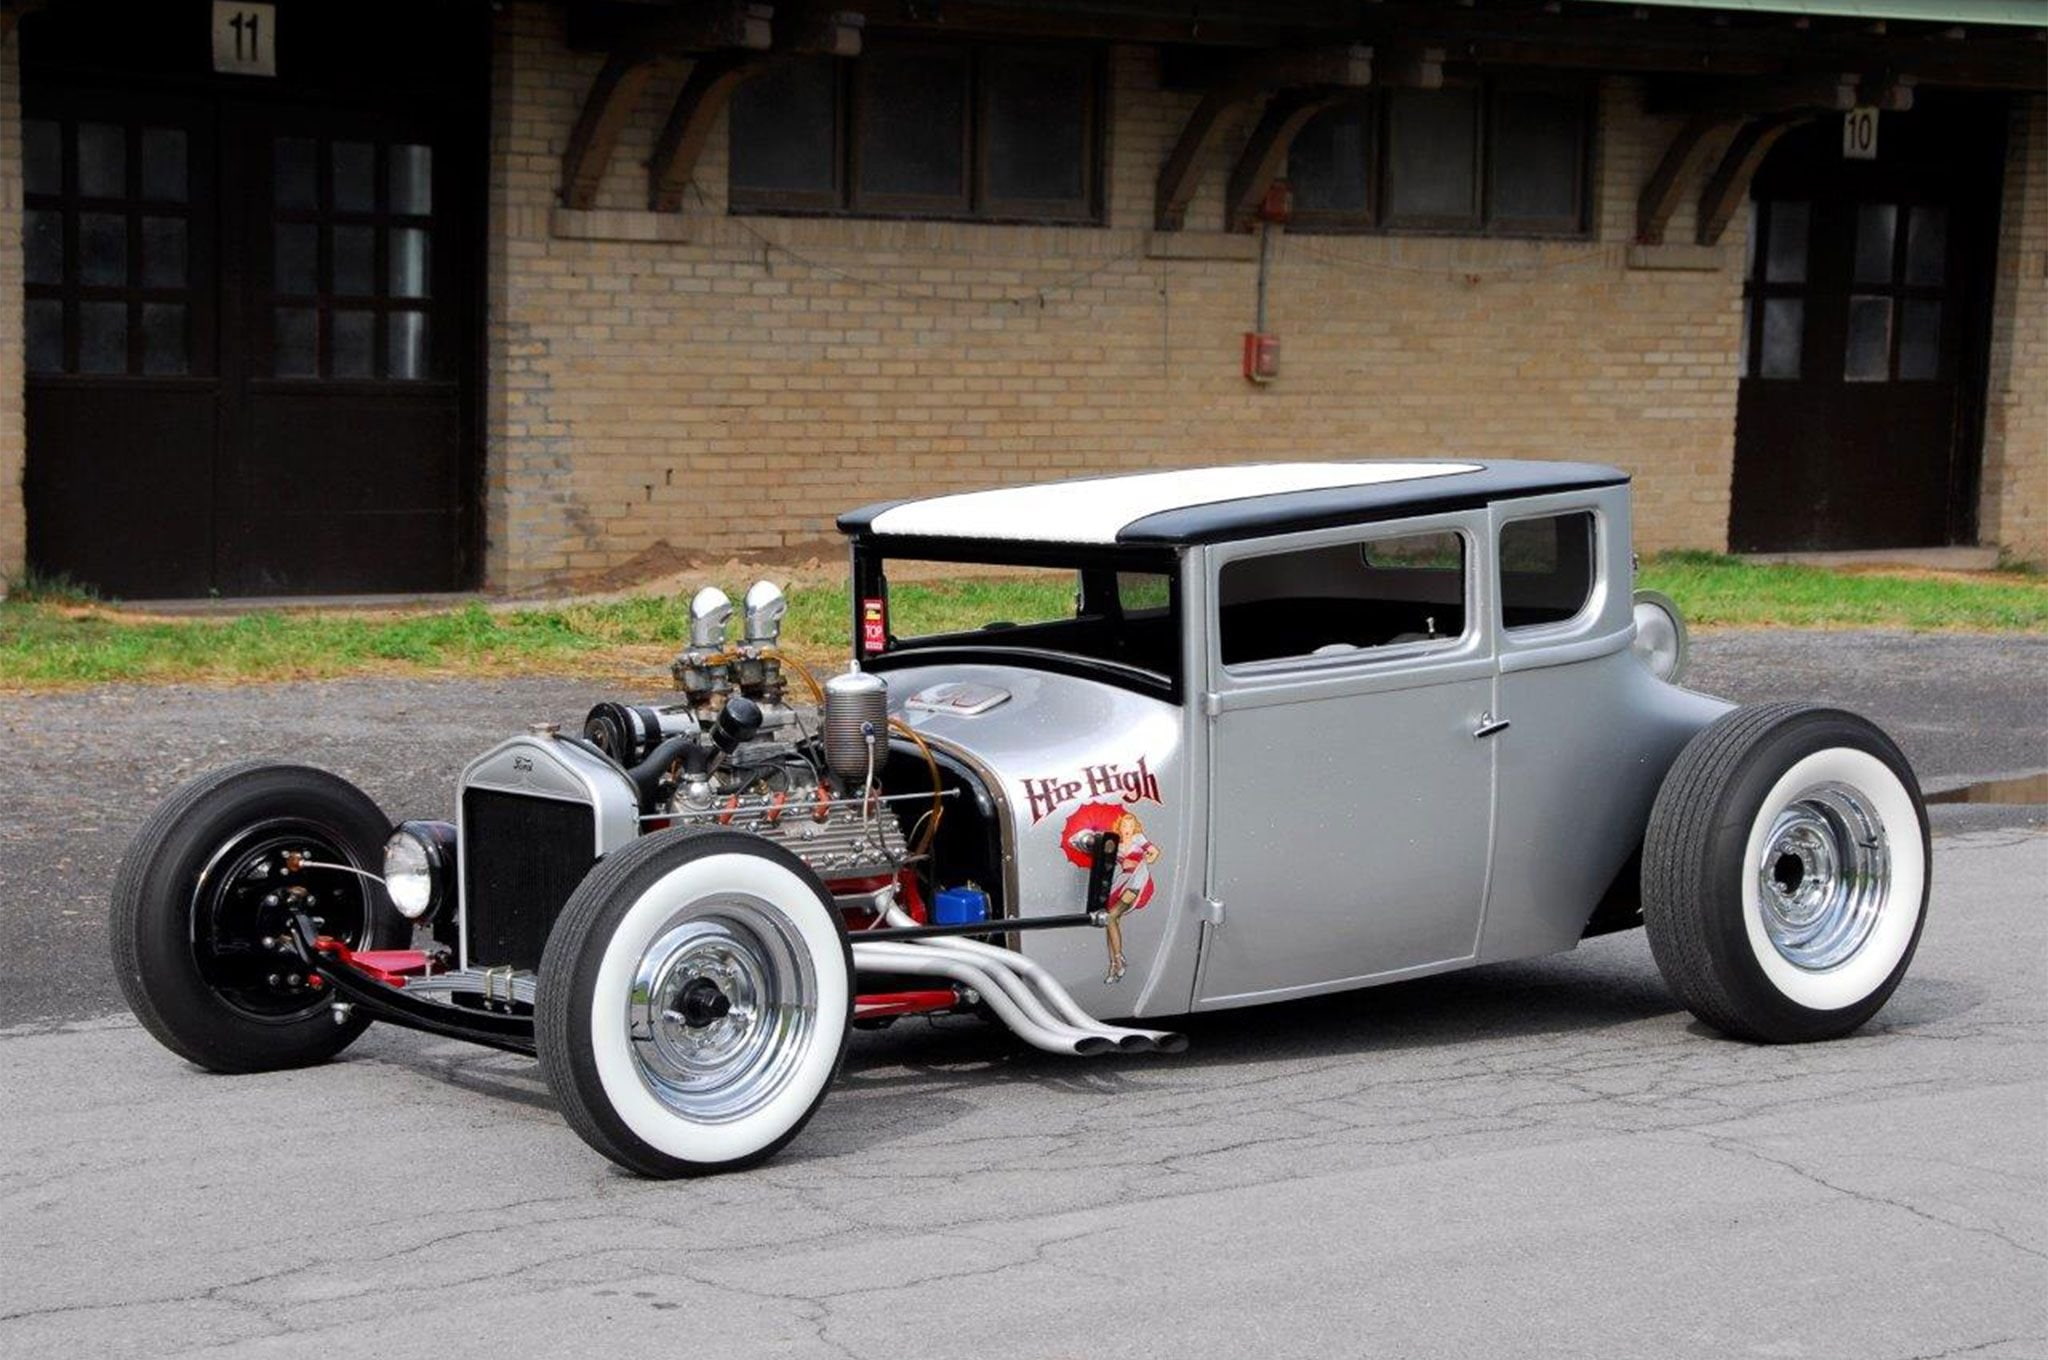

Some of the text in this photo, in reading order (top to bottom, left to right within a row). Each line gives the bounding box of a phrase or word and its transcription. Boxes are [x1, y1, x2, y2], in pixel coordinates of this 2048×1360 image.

[230, 11, 258, 62] 11
[1849, 113, 1872, 151] 10
[865, 624, 883, 639] TOP
[1081, 752, 1164, 805] High
